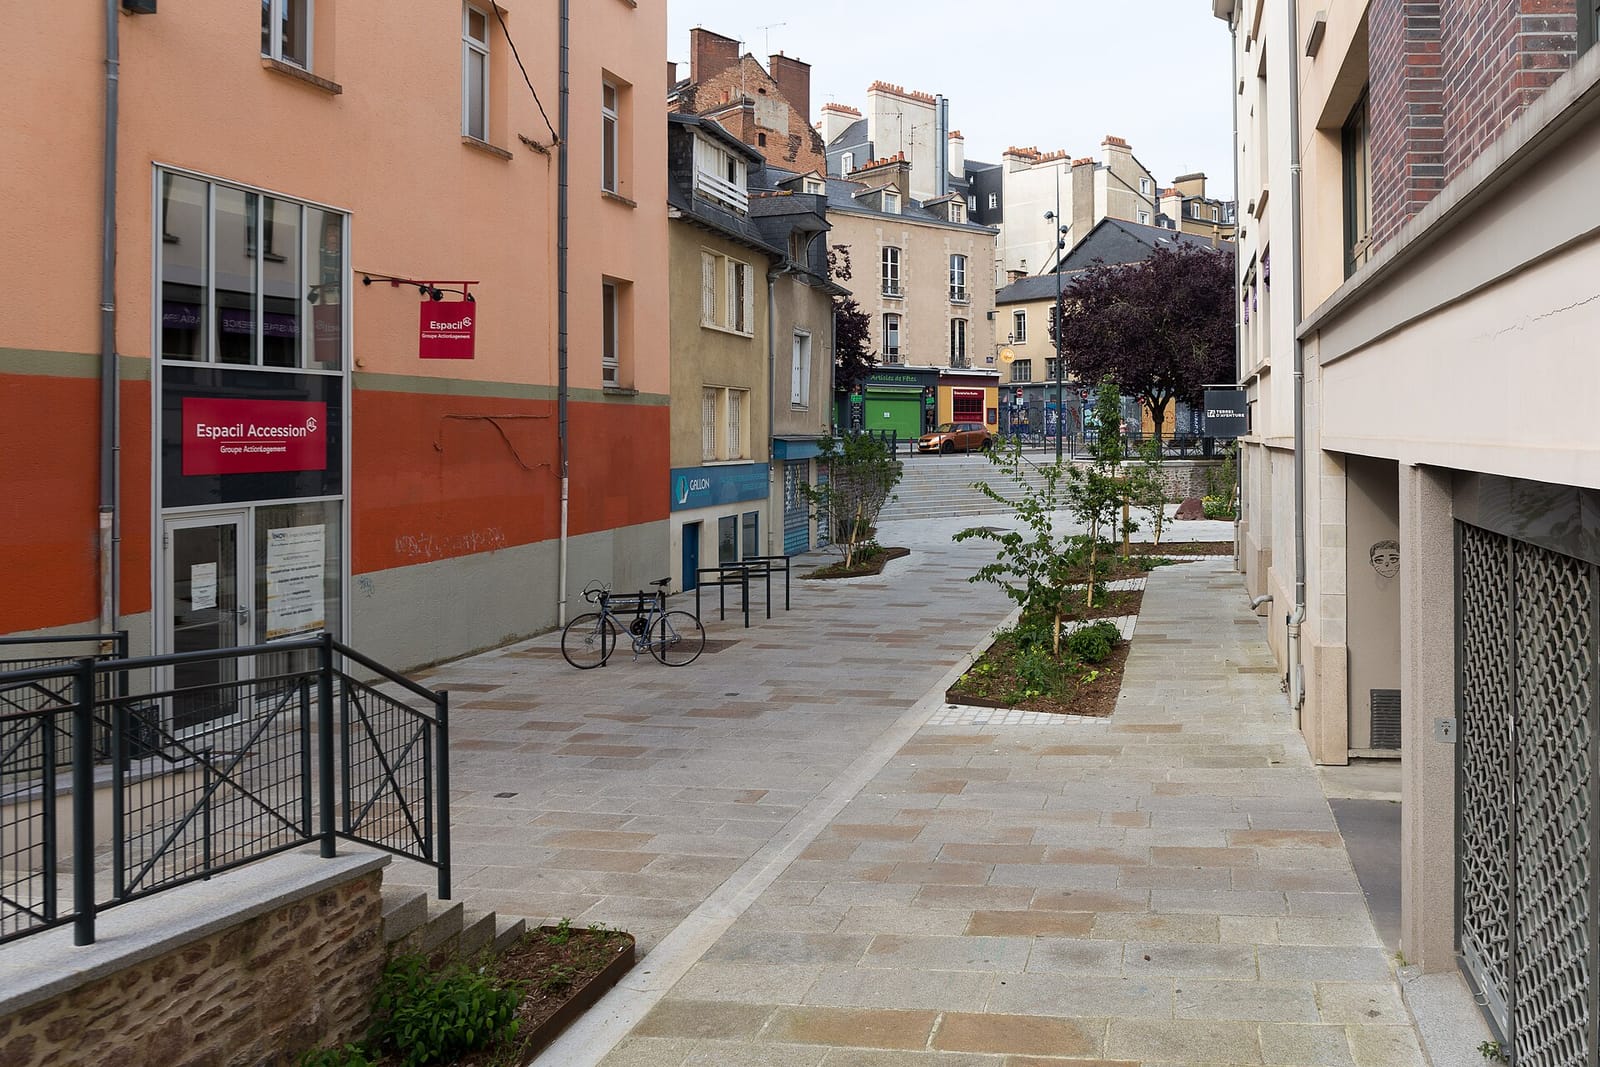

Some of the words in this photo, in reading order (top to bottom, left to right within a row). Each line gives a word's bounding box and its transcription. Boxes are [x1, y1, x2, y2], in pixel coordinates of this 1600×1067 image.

[430, 320, 462, 330] Espacil
[196, 423, 243, 440] Espacil
[247, 424, 306, 437] Accession
[220, 445, 242, 455] Groupe
[243, 445, 286, 455] ActionLogement
